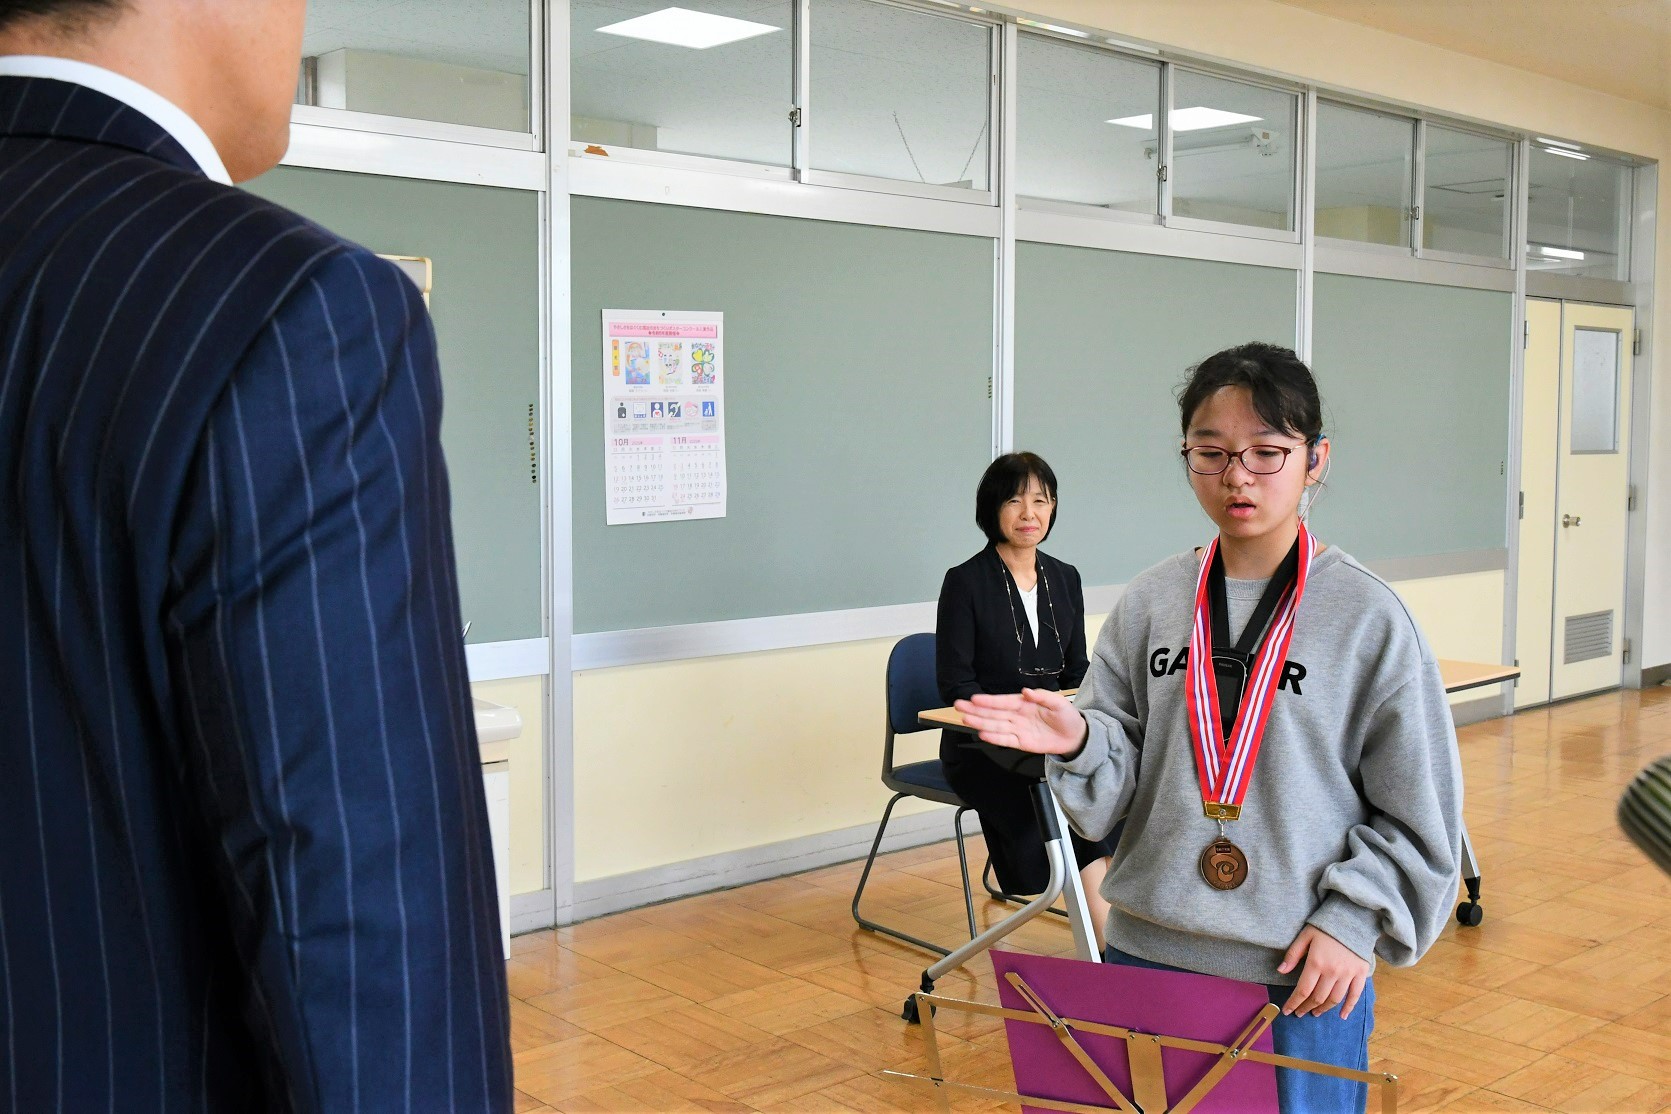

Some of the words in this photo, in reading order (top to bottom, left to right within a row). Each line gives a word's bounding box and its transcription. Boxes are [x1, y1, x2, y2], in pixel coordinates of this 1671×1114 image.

[614, 438, 629, 446] 10月
[673, 436, 687, 444] 11月
[1150, 646, 1307, 696] GAR
